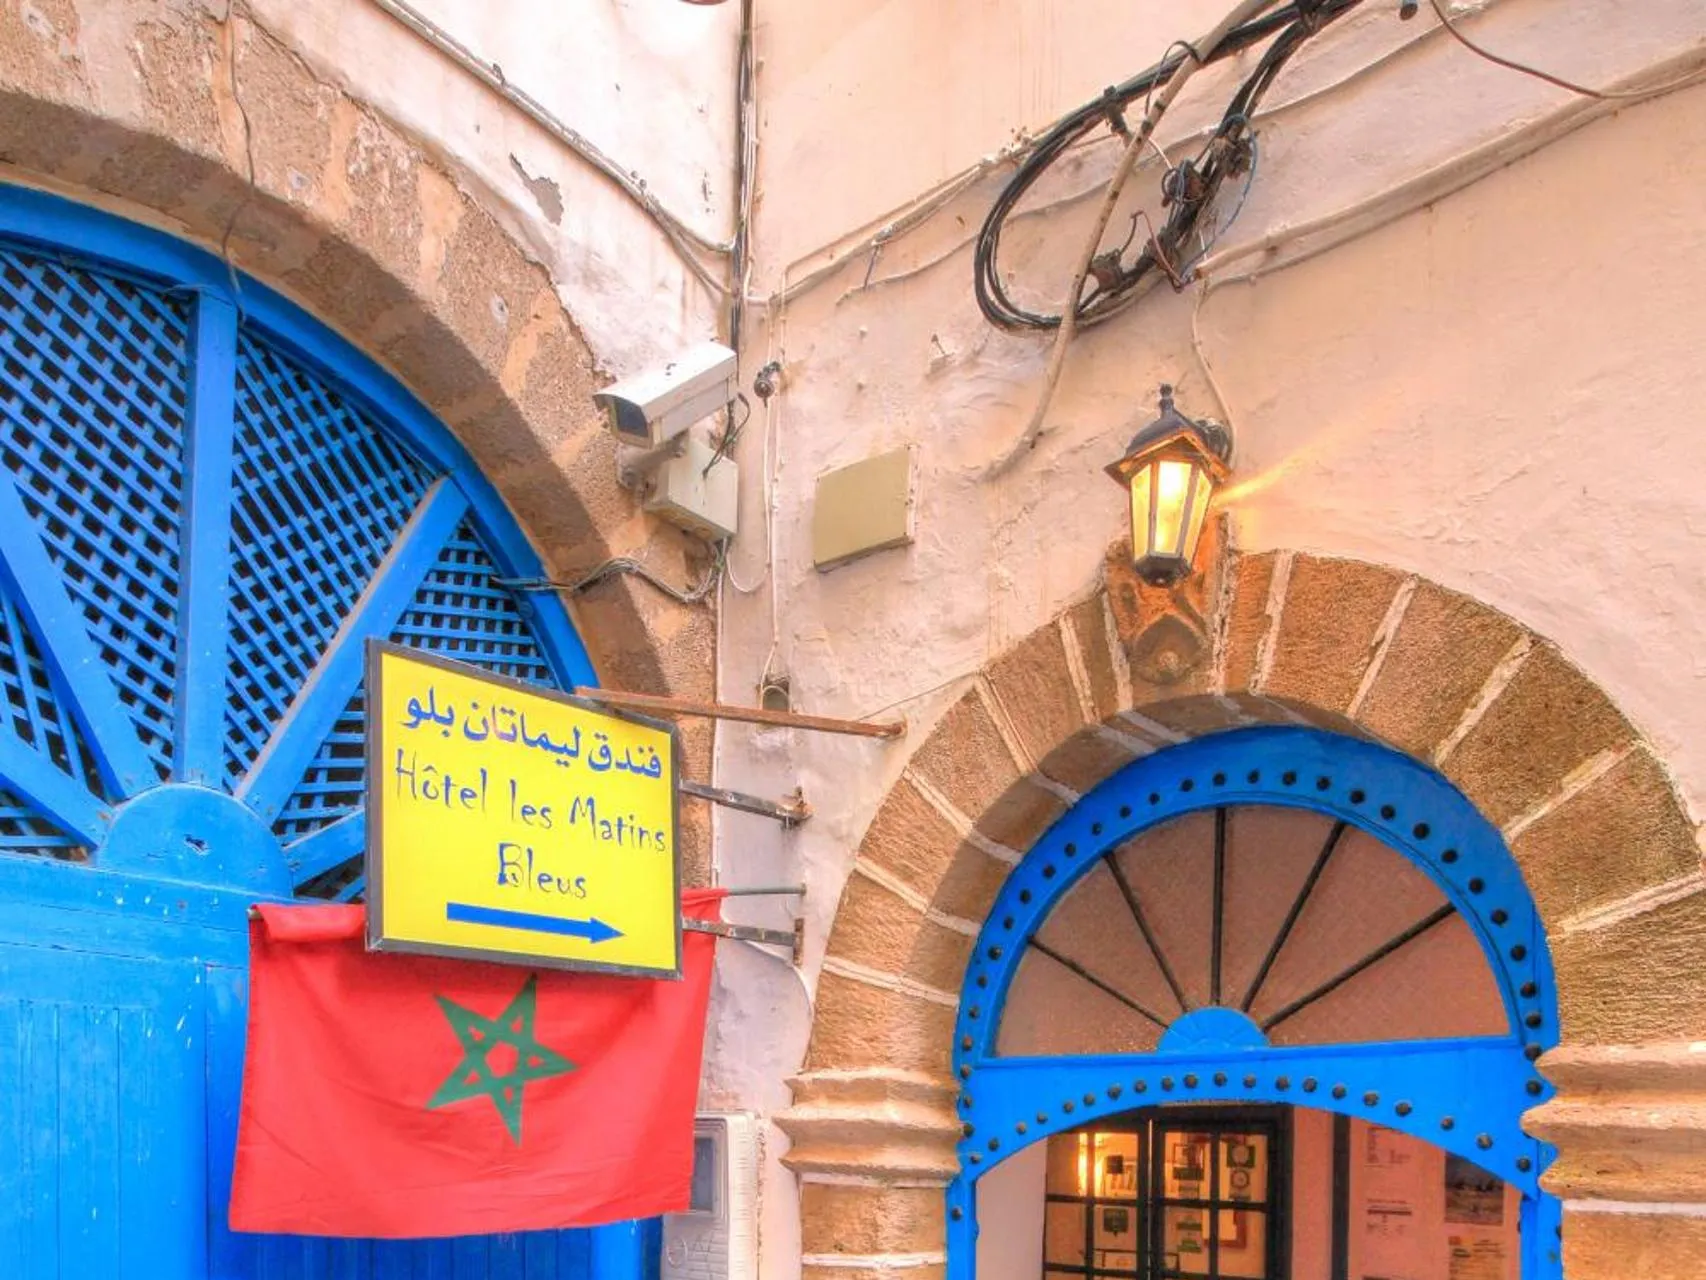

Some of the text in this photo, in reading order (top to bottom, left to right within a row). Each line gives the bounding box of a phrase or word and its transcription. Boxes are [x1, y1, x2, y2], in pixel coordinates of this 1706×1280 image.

[398, 685, 662, 779] فندق ليماتان بلو
[396, 748, 666, 853] Hôtel les Matins
[497, 842, 588, 899] Bleus
